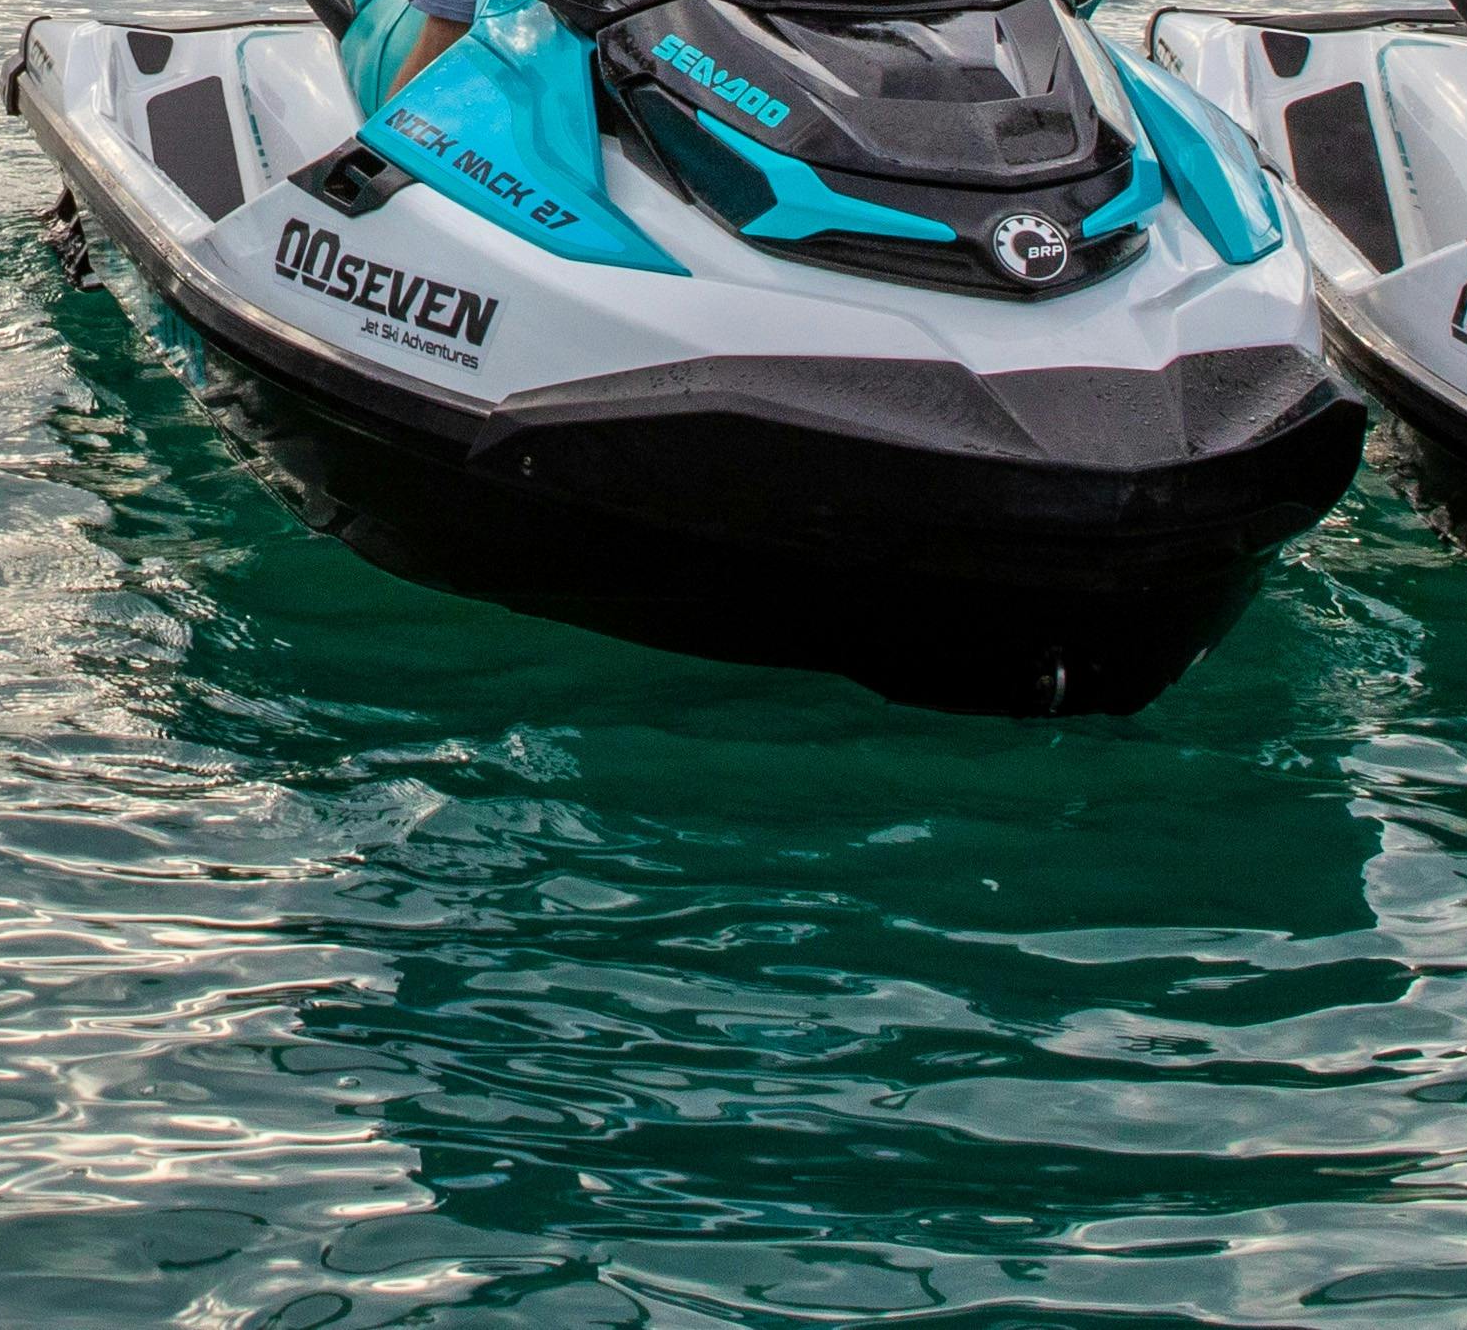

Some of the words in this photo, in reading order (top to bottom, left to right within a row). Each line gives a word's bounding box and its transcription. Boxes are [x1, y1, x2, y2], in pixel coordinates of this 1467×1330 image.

[385, 108, 458, 158] NICK
[453, 149, 535, 208] NACK
[529, 199, 580, 230] 27
[1027, 243, 1064, 259] BRP
[361, 317, 380, 336] Jet
[381, 323, 400, 343] Ski
[401, 331, 480, 370] Adventures
